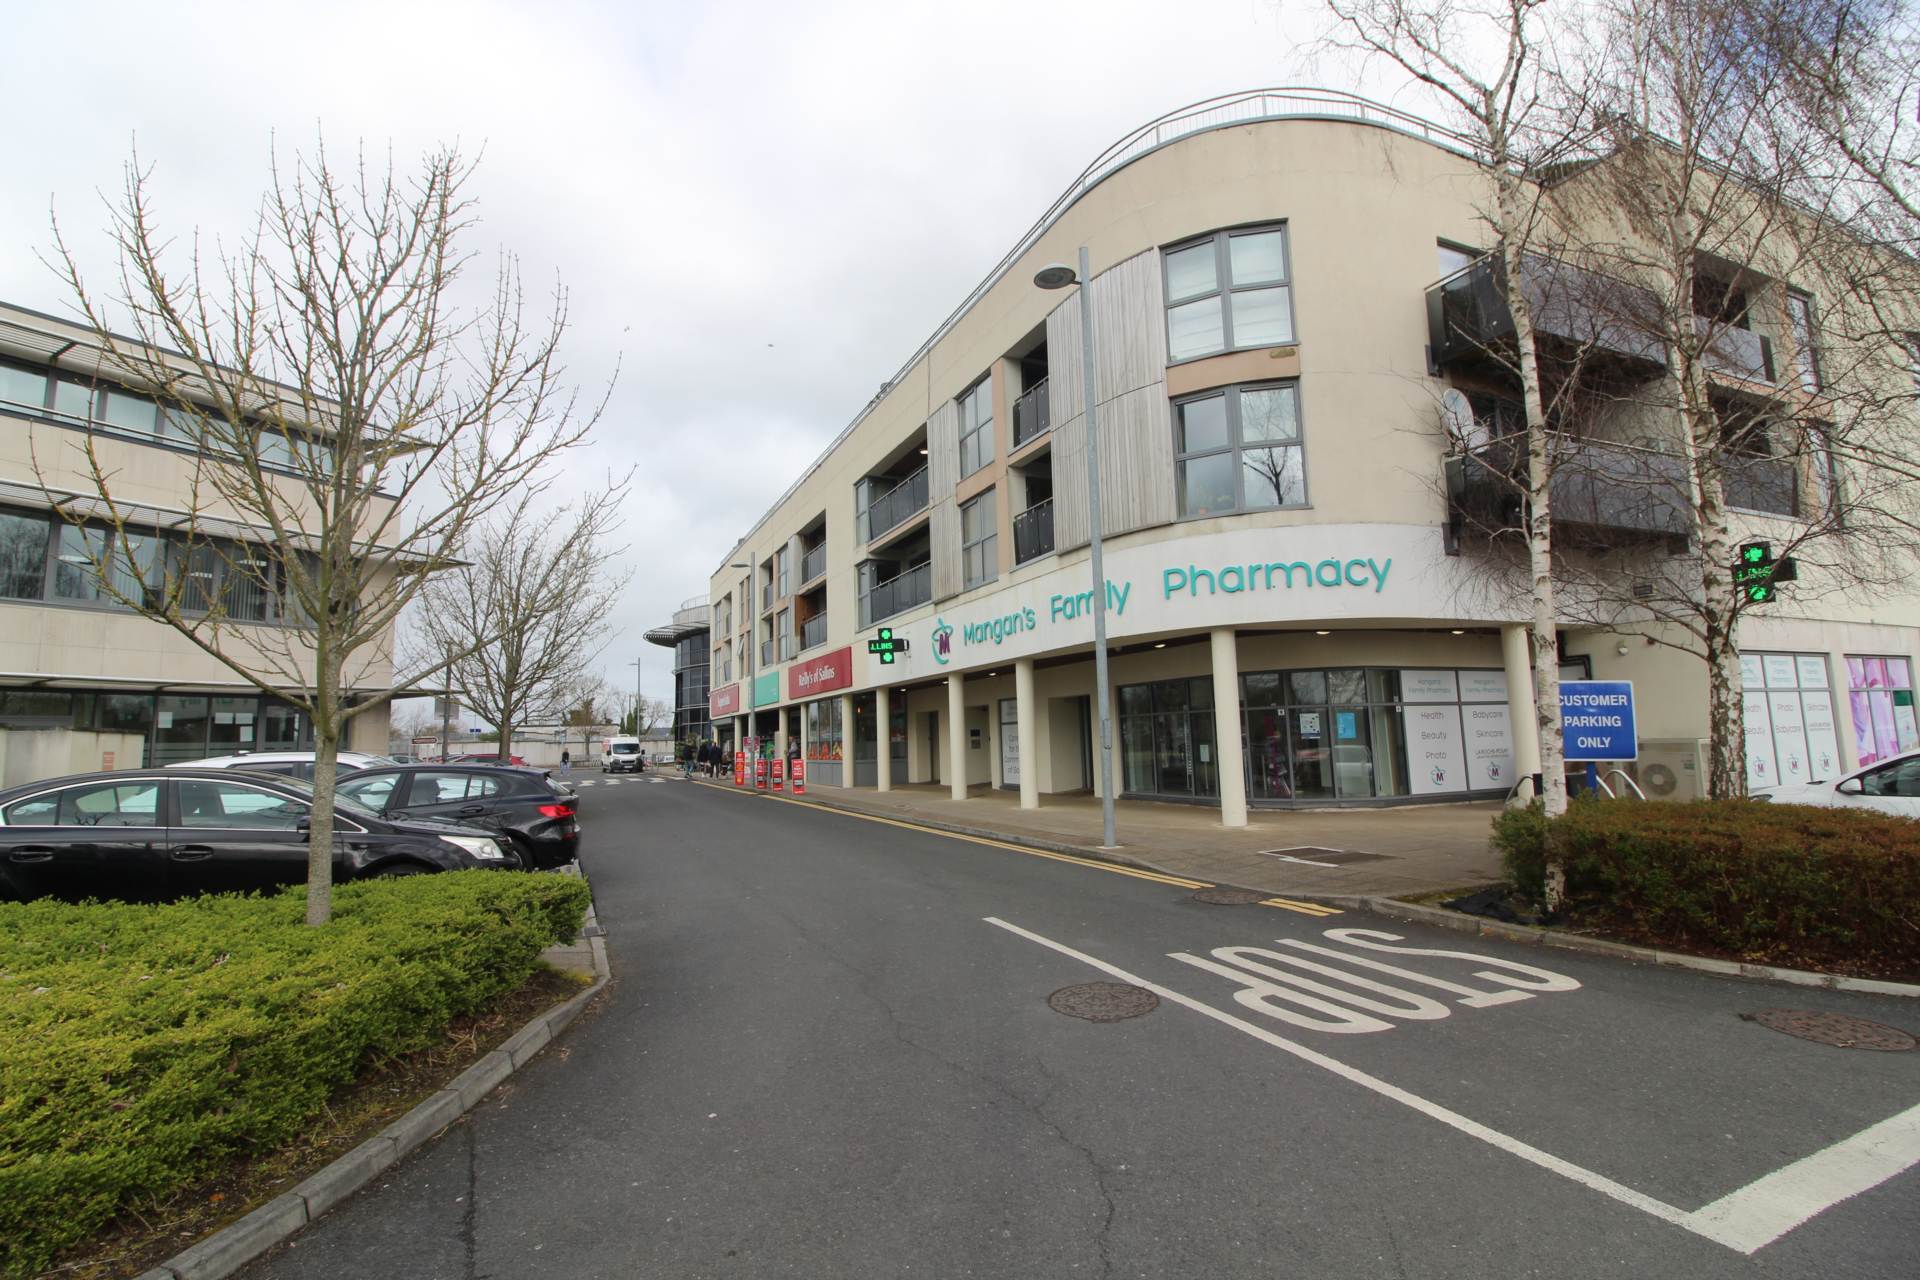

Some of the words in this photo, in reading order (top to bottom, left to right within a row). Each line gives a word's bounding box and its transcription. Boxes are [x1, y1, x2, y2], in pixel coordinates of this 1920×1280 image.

[963, 606, 1037, 647] Mangan's
[1051, 578, 1132, 624] Famly
[1163, 557, 1392, 601] Pharmacy
[1420, 711, 1445, 720] Health
[1564, 715, 1622, 727] PARKING
[1421, 731, 1447, 741] Beauty
[1577, 736, 1612, 748] ONLY
[1425, 751, 1447, 760] Photo
[1165, 928, 1583, 1034] STOP
